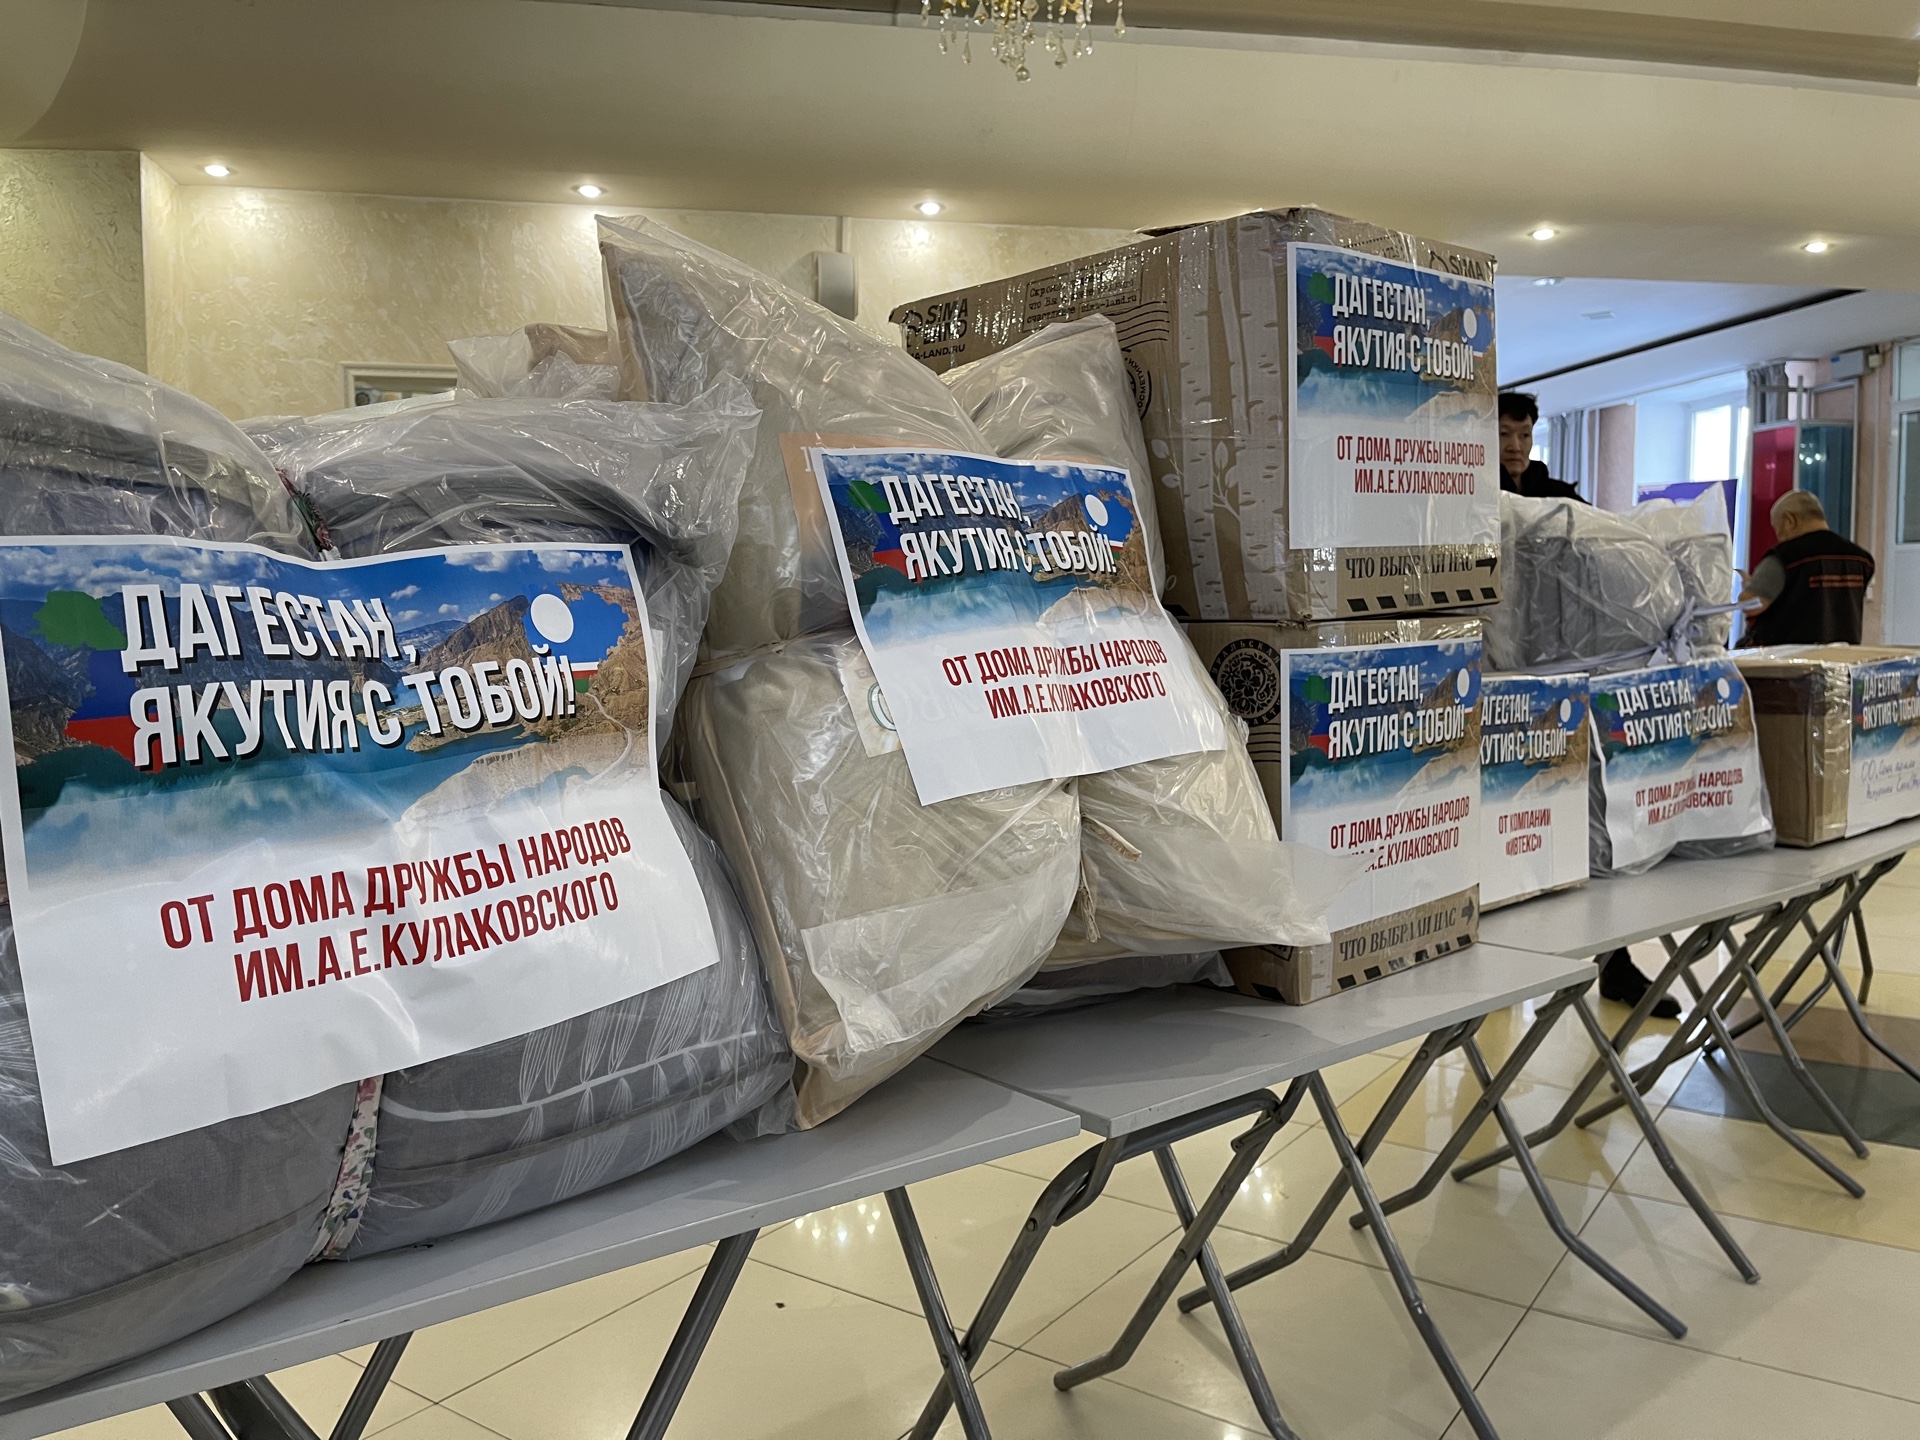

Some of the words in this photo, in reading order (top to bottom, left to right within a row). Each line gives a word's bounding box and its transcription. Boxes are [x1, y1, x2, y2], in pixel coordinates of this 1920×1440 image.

[926, 298, 968, 324] SIMA
[1081, 295, 1137, 313] sima-land.ru
[1331, 272, 1431, 331] ДАГЕСТАН,
[911, 344, 965, 359] A-LAND.RU
[1332, 325, 1405, 371] ЯКУТИЯ
[1409, 338, 1421, 373] С
[1422, 332, 1474, 380] ТОБОЙ!
[1128, 358, 1146, 411] ОСМЕТИКИ
[1336, 436, 1353, 461] ОТ
[1355, 436, 1391, 464] ДОМА
[1394, 438, 1442, 467] ДРУЖБЫ
[1444, 441, 1485, 469] НАРОДОВ
[881, 475, 1033, 528] ДАГЕСТАН,
[1354, 468, 1474, 496] ИМ.А.Е.КУЛАКОВСКОГО
[900, 527, 1018, 581] ЯКУТИЯ
[1014, 529, 1032, 574] С
[1033, 525, 1117, 574] ТОБОЙ!
[1346, 557, 1375, 579] ЧТО
[1379, 553, 1446, 577] ВЫБРАЛИ
[1448, 552, 1473, 573] НАС
[121, 583, 421, 673] ДАГЕСТАН,
[942, 655, 974, 686] ОТ
[975, 647, 1034, 682] ДОМА
[1034, 642, 1100, 679] ДРУЖБЫ
[1100, 639, 1167, 669] НАРОДОВ
[1212, 640, 1280, 674] УРАЛЬСКАЯ
[130, 678, 361, 768] ЯКУТИЯ
[363, 685, 404, 746] С
[404, 645, 577, 736] ТОБОЙ!
[985, 681, 1166, 719] ИМ.А.Е.КУЛАКОВСКОГО
[1328, 664, 1424, 715] ДАГЕСТАН,
[1481, 693, 1533, 726] АГЕСТАН,
[1616, 678, 1695, 717] ДАГЕСТАН,
[1328, 713, 1398, 760] ЯКУТИЯ
[1403, 714, 1414, 748] С
[1417, 699, 1465, 745] ТОБОЙ!
[1623, 713, 1683, 747] ЯКУТИЯ
[1684, 710, 1692, 736] С
[1862, 704, 1892, 731] ЯКУТИЯ
[1892, 700, 1899, 724] С
[1480, 732, 1515, 765] КУТИЯ
[1516, 731, 1525, 760] С
[1527, 723, 1567, 759] ТОБОЙ!
[1635, 789, 1646, 808] ОТ
[1648, 785, 1671, 806] ДОМА
[1698, 768, 1744, 788] НАРОДОВ
[1330, 825, 1346, 850] ОТ
[1348, 818, 1383, 849] ДОМА
[1384, 807, 1430, 840] ДРУЖБЫ
[1431, 796, 1470, 829] НАРОДОВ
[1498, 815, 1508, 834] ОТ
[1509, 808, 1551, 832] КОМПАНИИ
[160, 894, 215, 950] ОТ
[233, 870, 353, 943] ДОМА
[364, 844, 515, 917] ДРУЖБЫ
[523, 817, 631, 879] НАРОДОВ
[233, 872, 619, 1002] ИМ.А.Е.КУЛАКОВСКОГО
[1340, 937, 1367, 961] ЧТО
[1370, 915, 1432, 953] ВЫБРАЛИ
[1433, 907, 1456, 932] НАС
